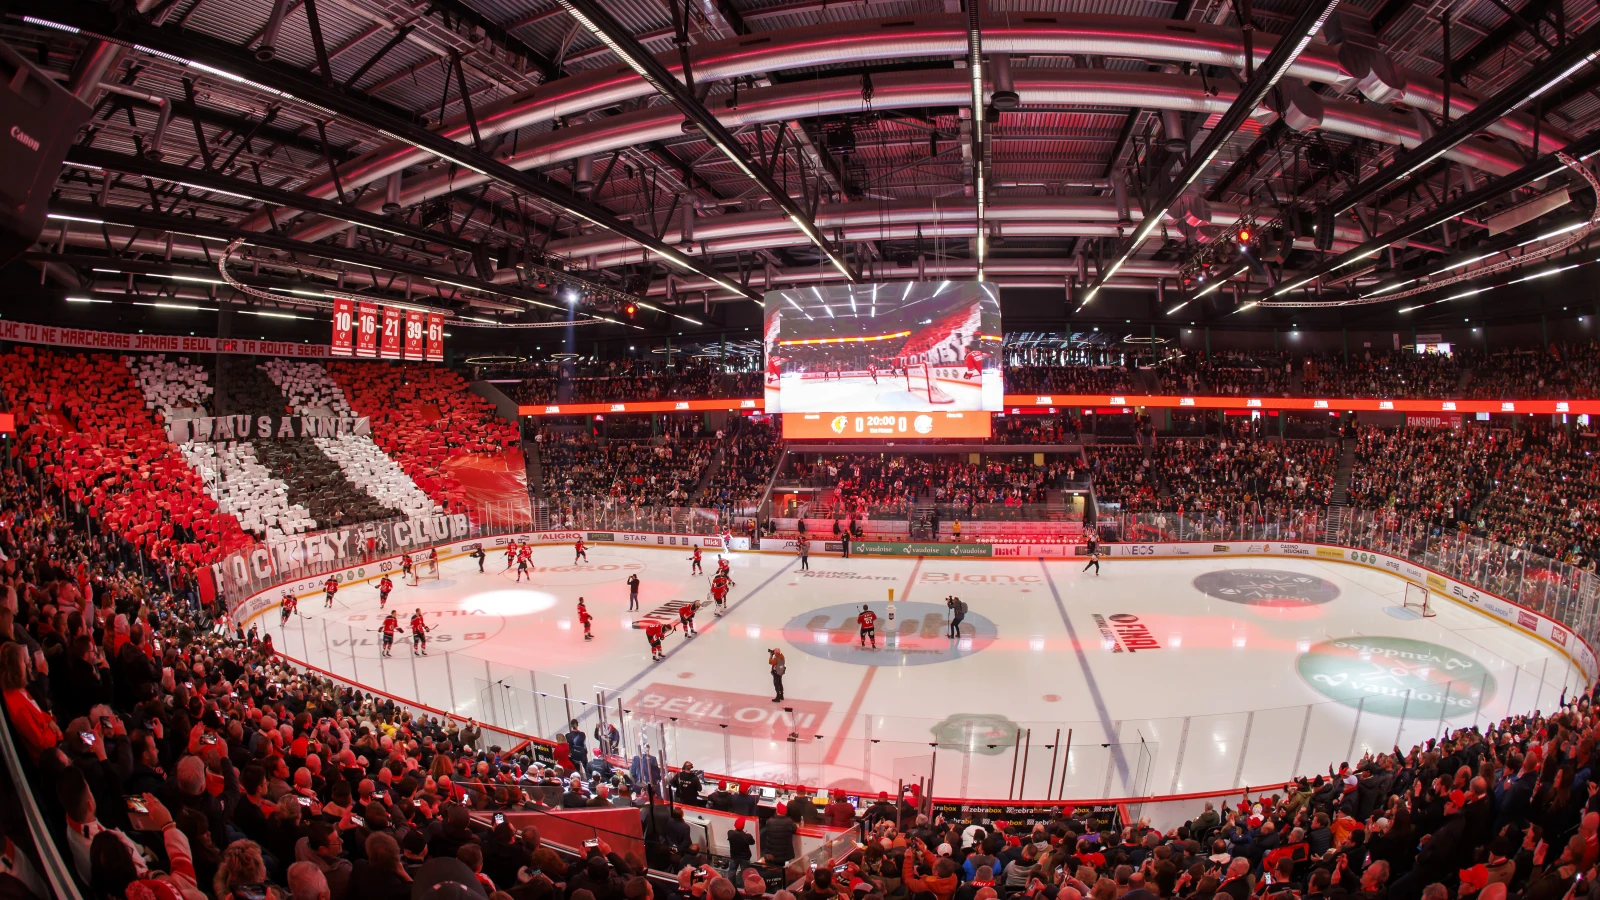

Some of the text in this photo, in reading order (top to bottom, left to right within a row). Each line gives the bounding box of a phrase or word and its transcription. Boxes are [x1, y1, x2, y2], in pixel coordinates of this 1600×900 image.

[10, 125, 40, 152] Canon
[335, 312, 350, 332] 10
[360, 315, 374, 334] 16
[385, 318, 398, 336] 21
[407, 321, 422, 340] 39
[24, 325, 38, 340] TU
[42, 328, 56, 342] NE
[61, 330, 130, 348] MARCHERAS
[135, 335, 178, 350] JAMAIS
[183, 338, 211, 350] SEUL
[216, 340, 237, 351] CAR
[242, 341, 256, 352] TA
[260, 342, 294, 355] ROUTE
[298, 345, 324, 356] SERA
[430, 324, 442, 341] 61
[191, 415, 354, 441] LAUSANNE
[856, 417, 864, 432] 0
[867, 416, 896, 426] 20:00
[898, 416, 907, 432] 0
[1408, 416, 1441, 428] FANSHOP
[394, 513, 468, 546] CLUB
[704, 538, 719, 546] Blick
[1122, 546, 1154, 555] INEOS
[994, 546, 1022, 556] naef
[1386, 560, 1400, 571] amag
[922, 572, 1042, 583] Blanc
[1114, 624, 1161, 652] FINAL
[1552, 628, 1566, 644] Blick
[1334, 641, 1442, 663] vaudoise
[1350, 680, 1473, 708] vaudoise
[637, 694, 816, 728] BELLONI
[970, 806, 1002, 814] zebrabox
